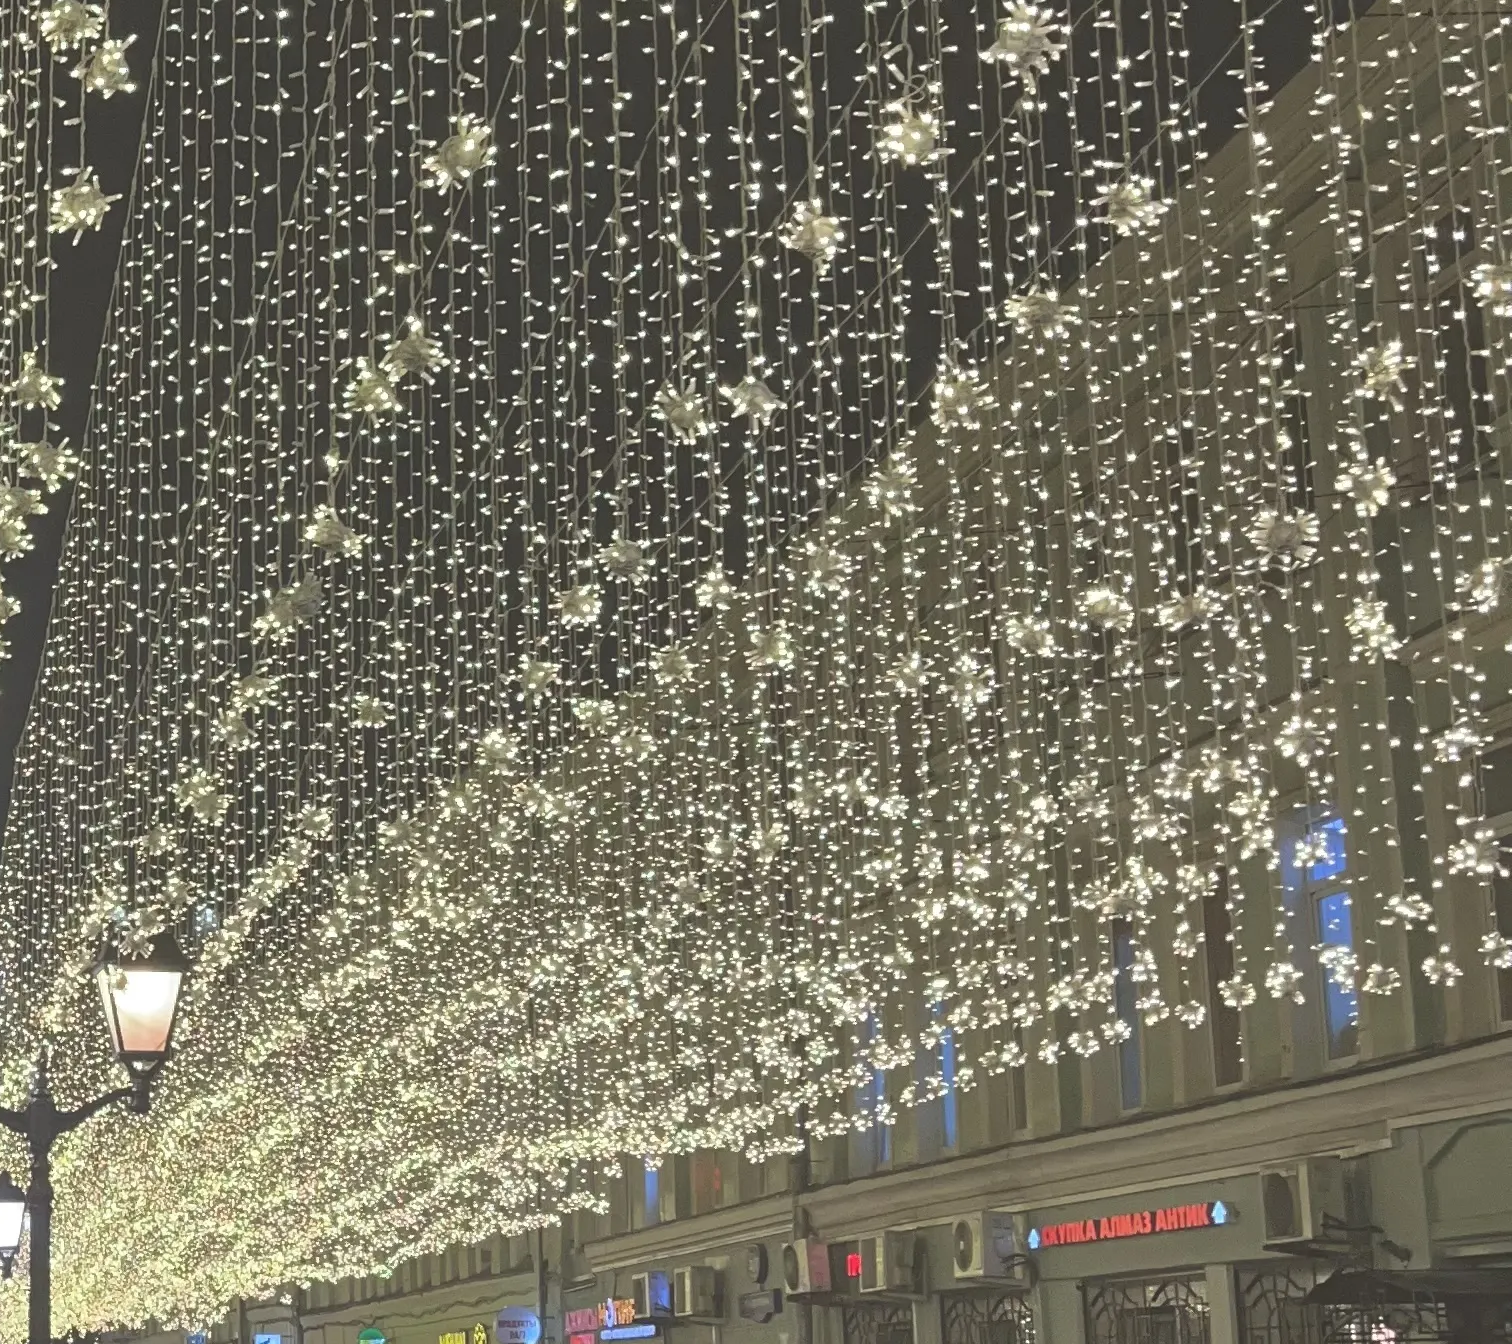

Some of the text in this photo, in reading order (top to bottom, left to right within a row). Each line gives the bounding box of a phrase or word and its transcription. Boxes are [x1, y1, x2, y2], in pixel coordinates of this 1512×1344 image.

[1041, 1203, 1209, 1248] СКУПКА АЛМАЗ АНТИК
